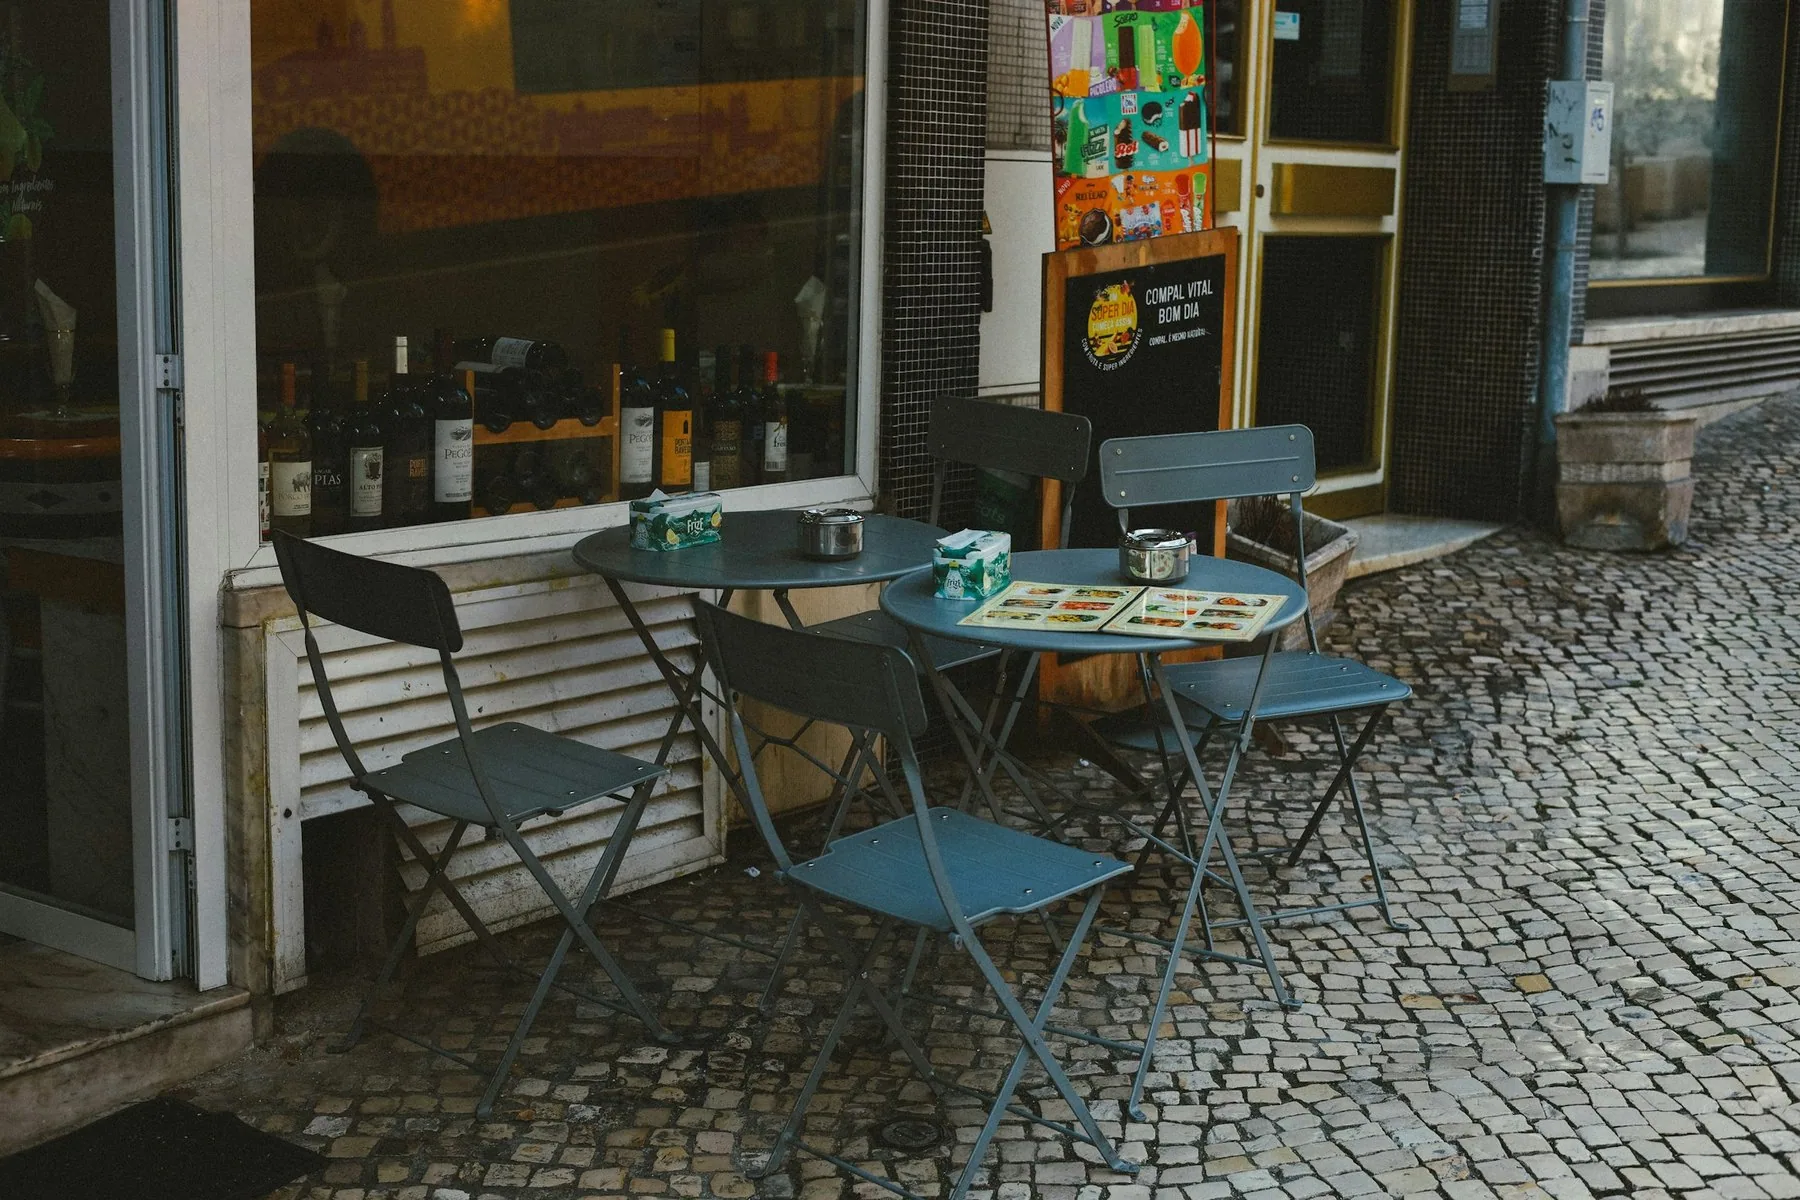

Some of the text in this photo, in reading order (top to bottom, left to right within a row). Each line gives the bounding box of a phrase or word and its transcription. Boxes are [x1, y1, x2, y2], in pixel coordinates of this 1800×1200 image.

[1051, 17, 1064, 32] NOVO
[1057, 180, 1071, 195] NOVO
[1145, 279, 1213, 306] COMPAL VITAL
[1158, 302, 1200, 324] BOM DIA
[314, 474, 342, 486] PIAS
